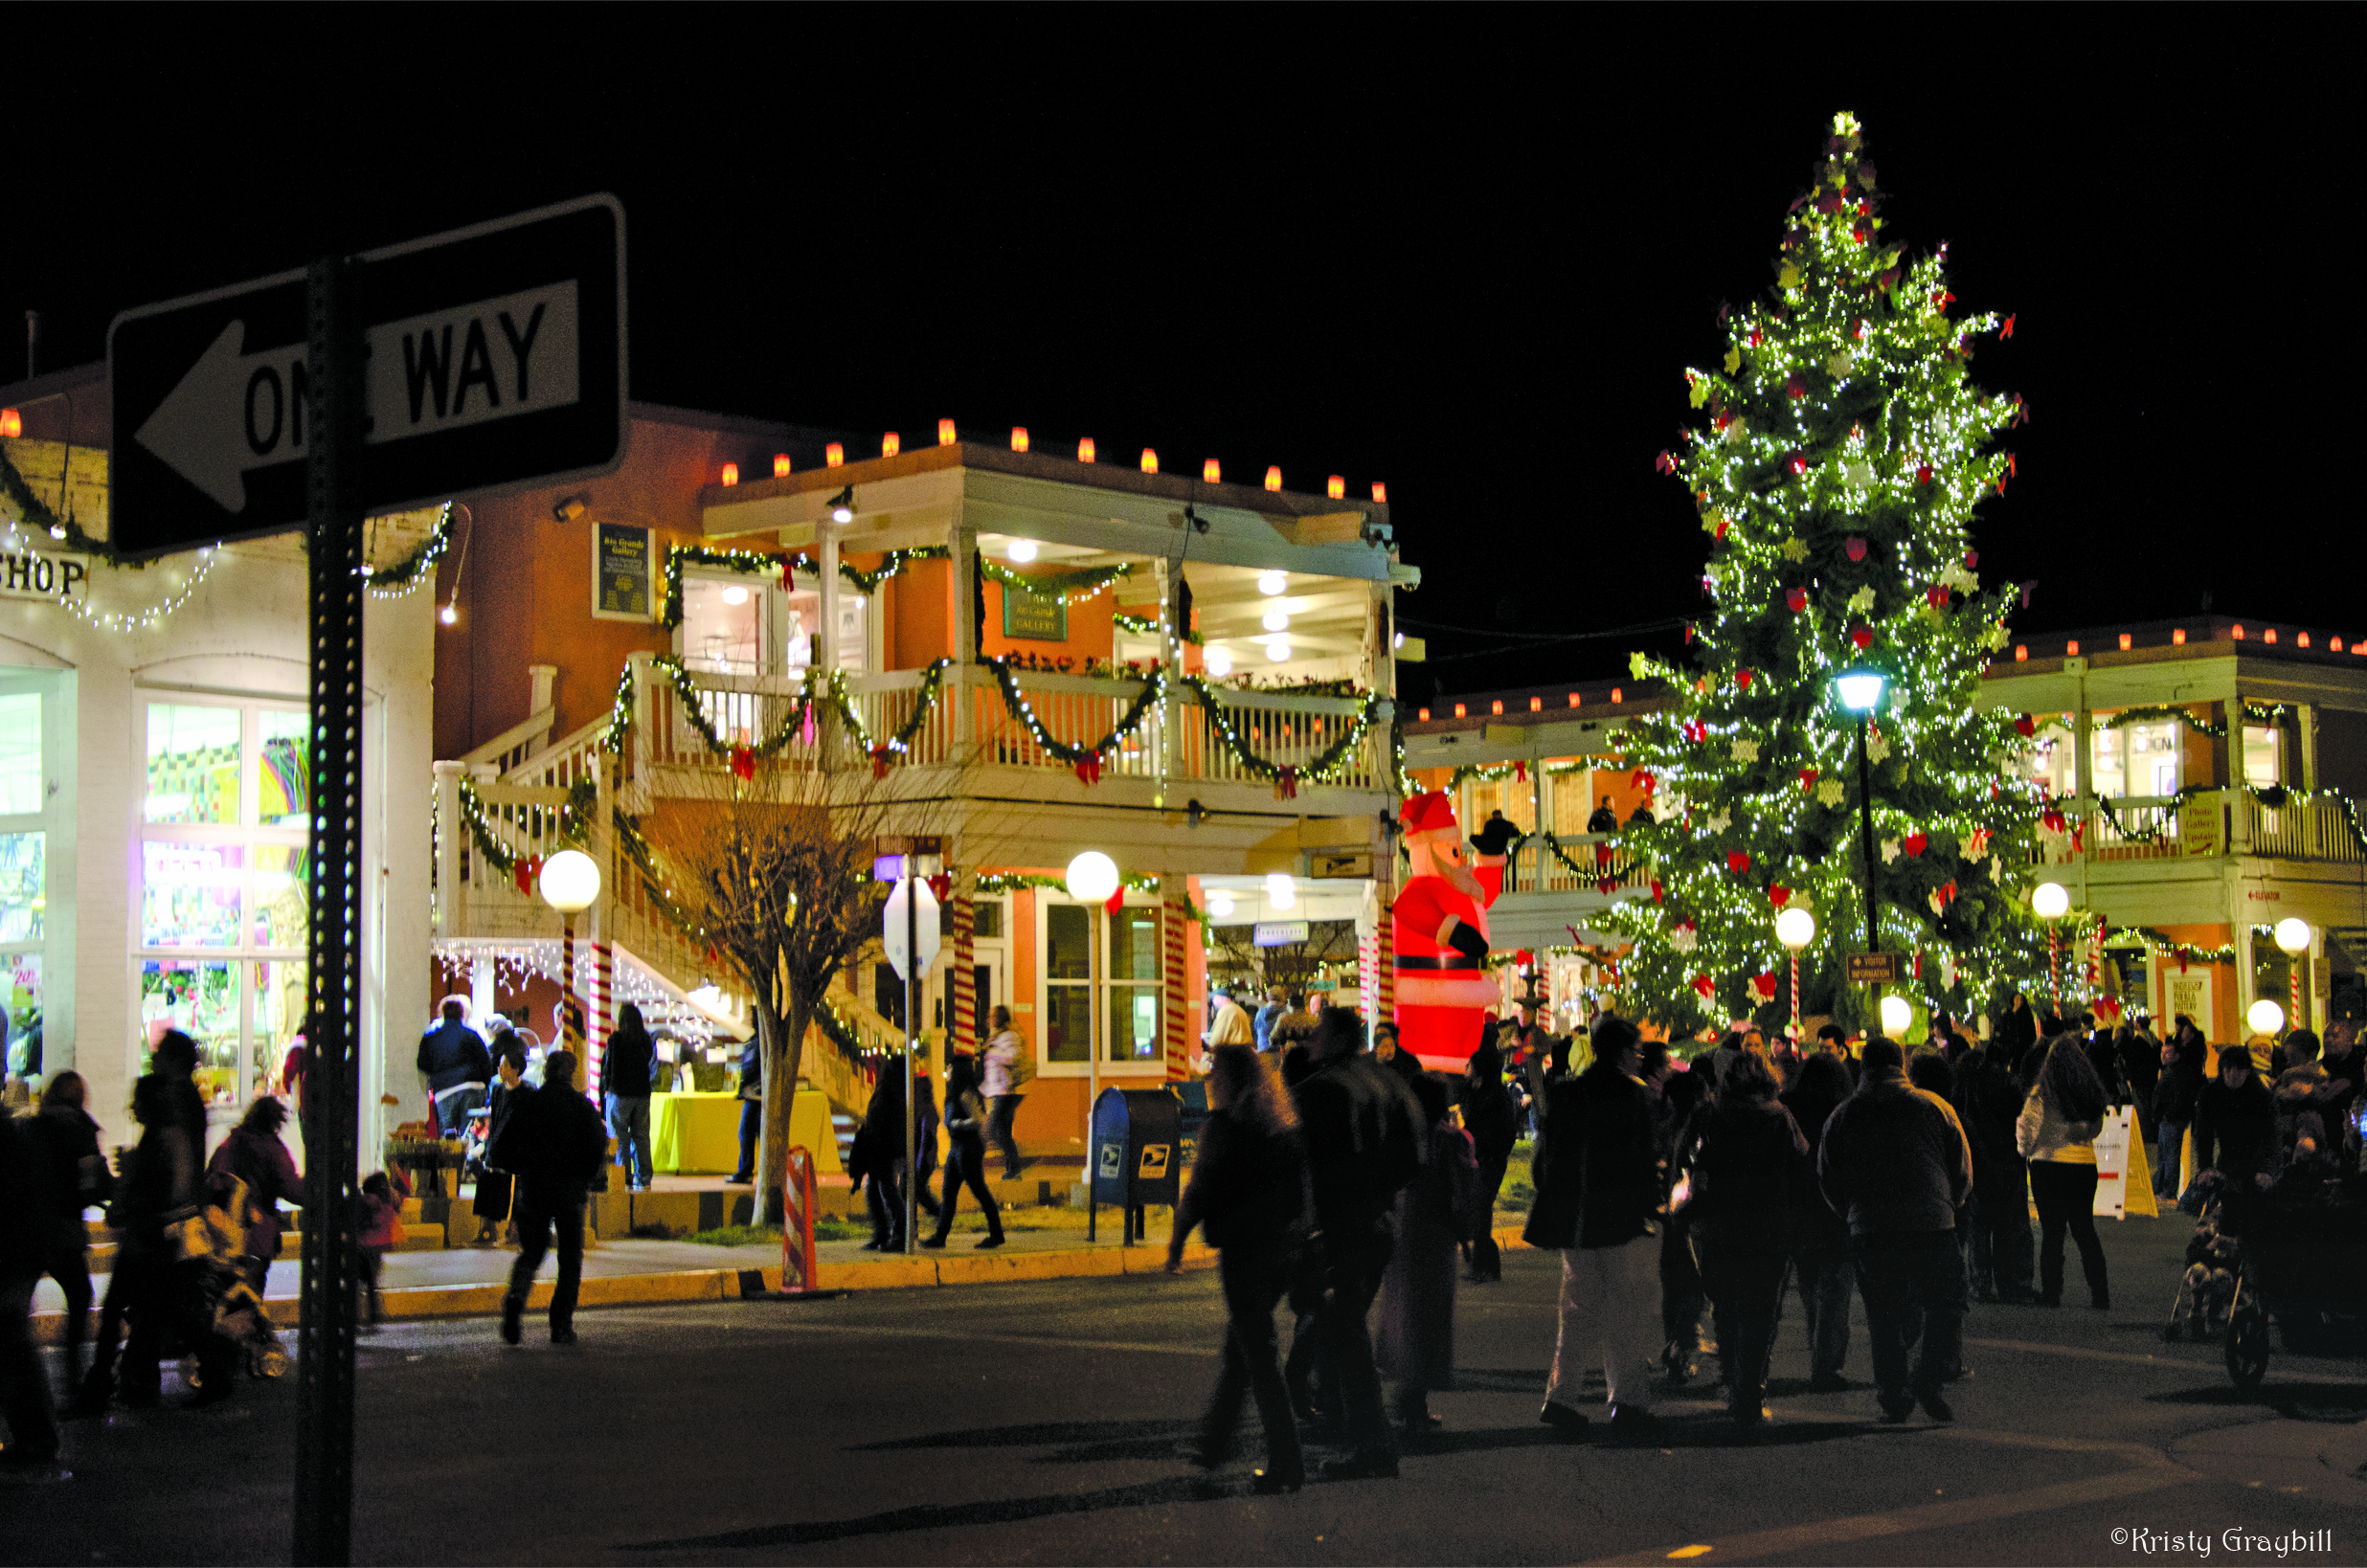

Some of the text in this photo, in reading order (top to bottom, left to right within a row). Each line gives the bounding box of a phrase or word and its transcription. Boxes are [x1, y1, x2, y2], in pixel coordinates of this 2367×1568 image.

[402, 302, 546, 424] WAY
[0, 552, 84, 594] HOP
[1016, 617, 1055, 631] GALLERY
[2189, 807, 2212, 817] Photo
[2185, 819, 2215, 828] Gallery
[2184, 833, 2219, 843] Upstairs
[2255, 890, 2280, 901] ELEVATOR
[1863, 957, 1886, 966] VISITOR
[1851, 968, 1890, 978] INFORMATION
